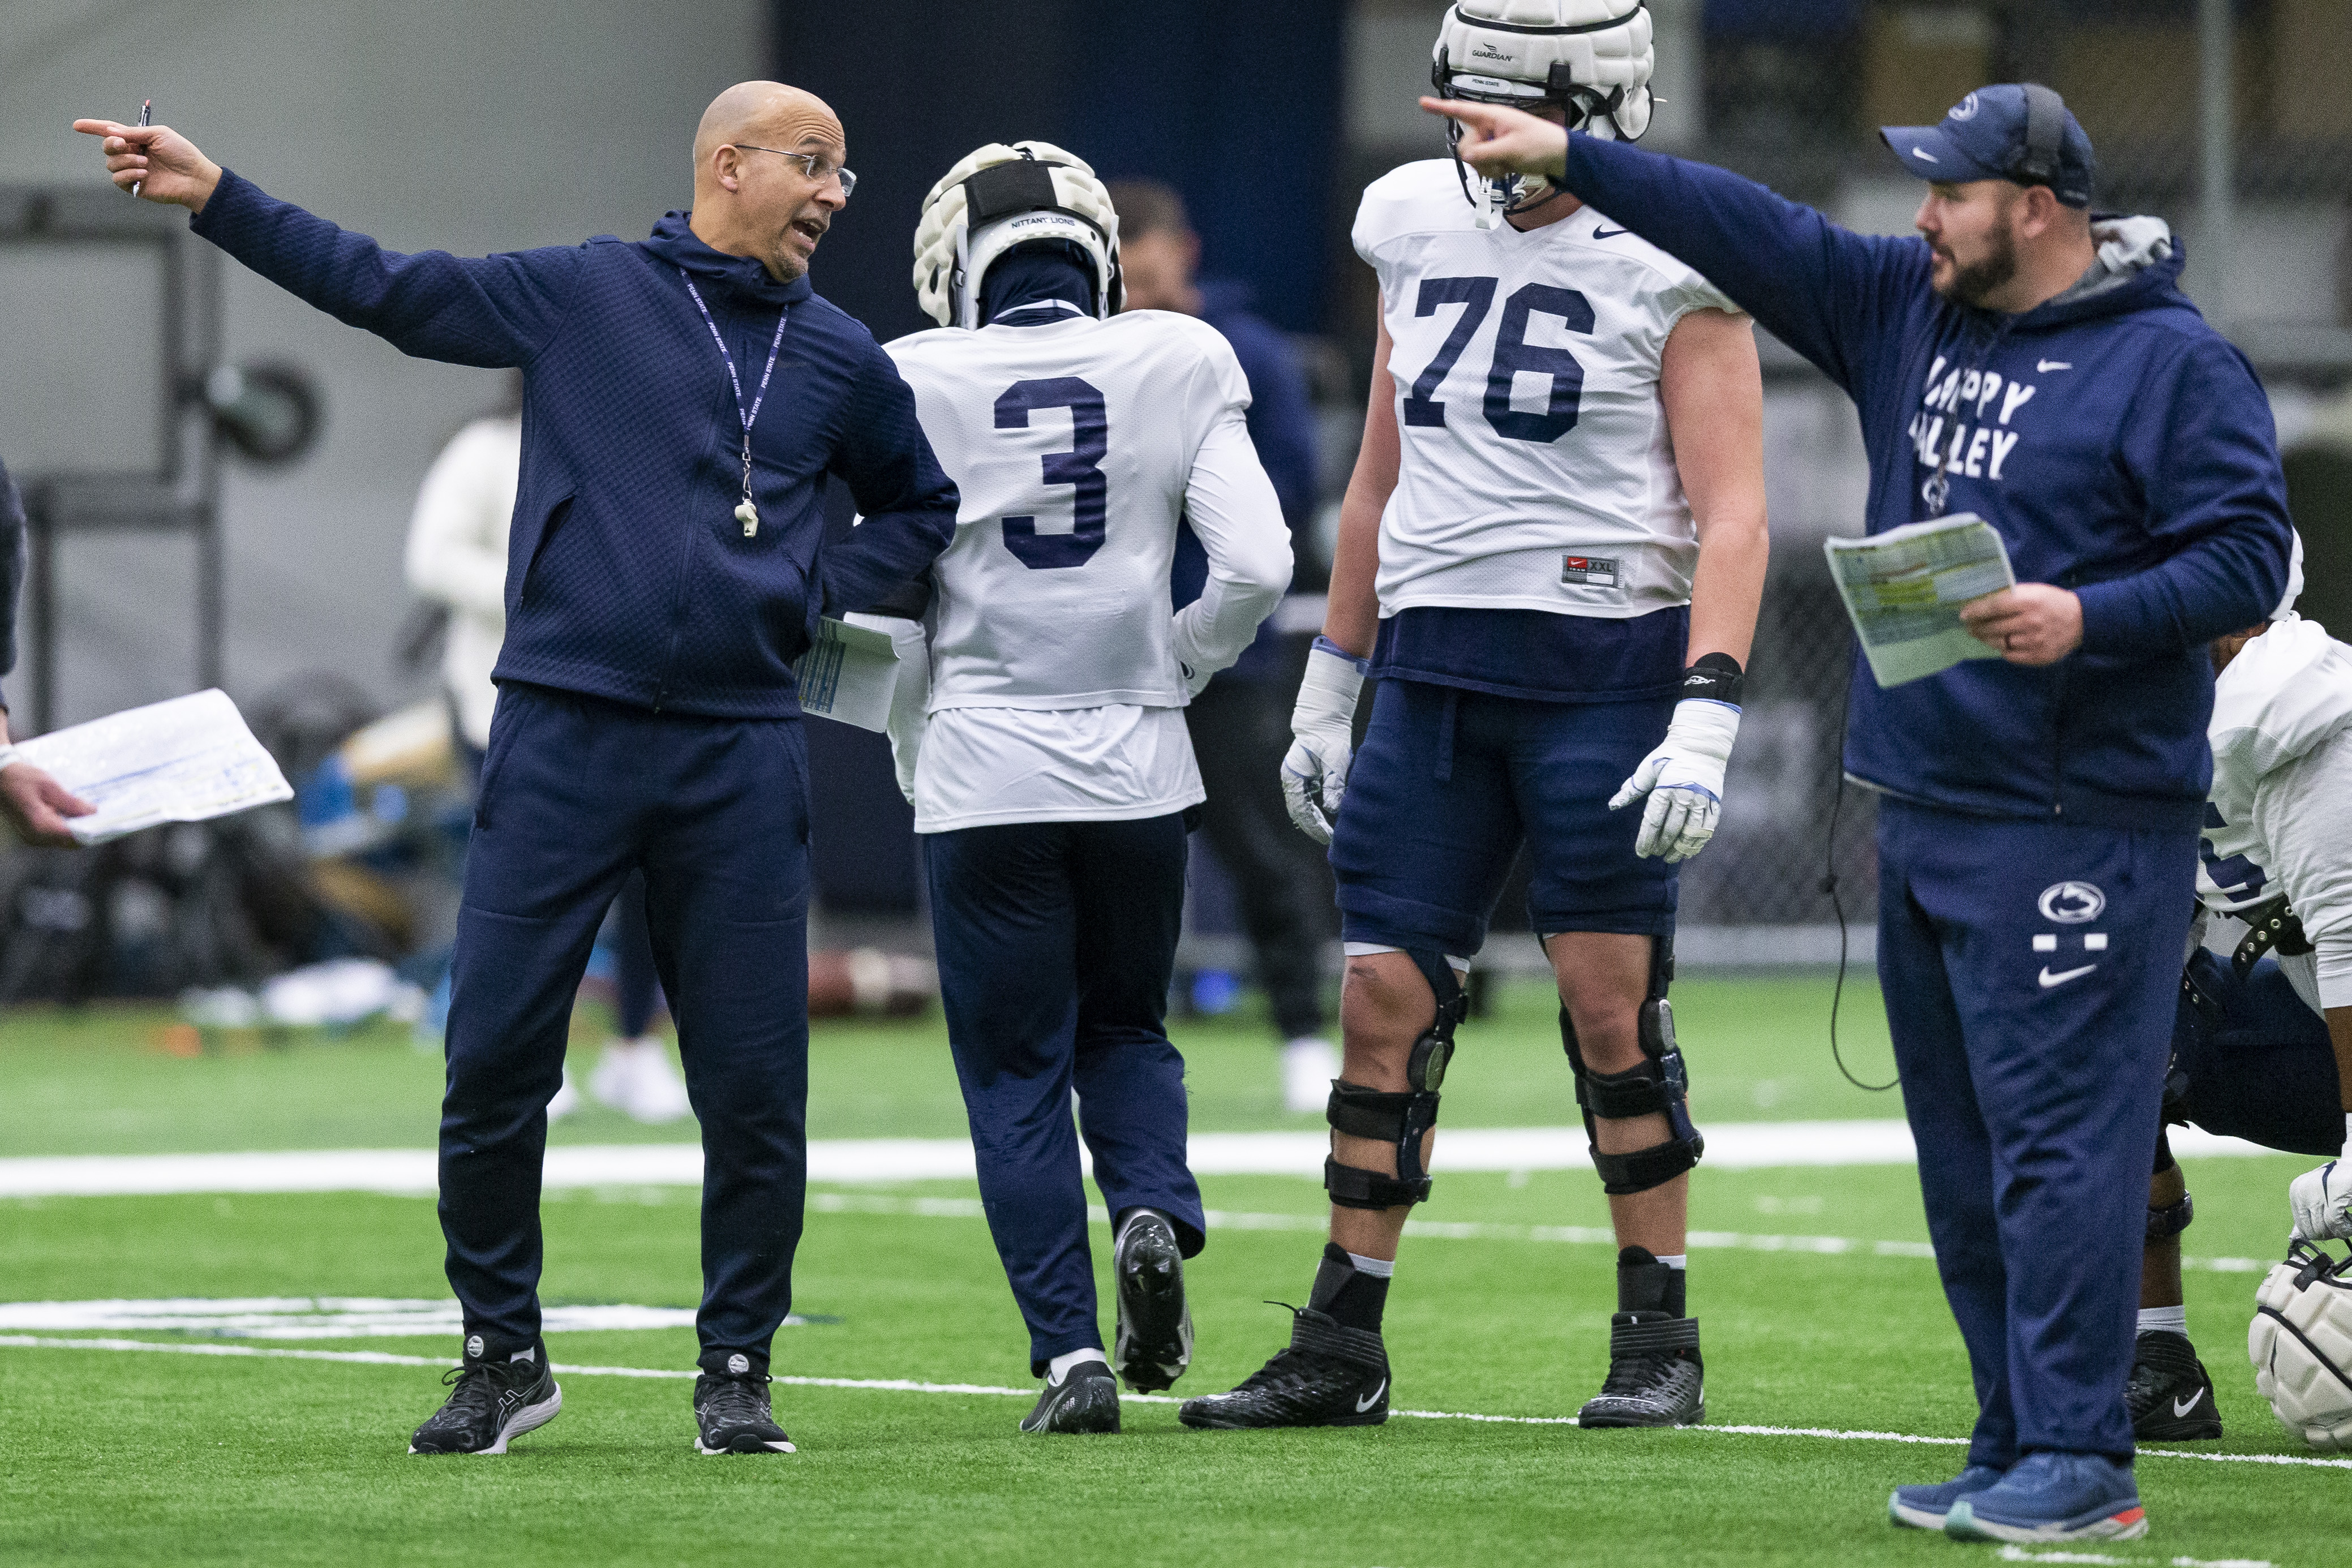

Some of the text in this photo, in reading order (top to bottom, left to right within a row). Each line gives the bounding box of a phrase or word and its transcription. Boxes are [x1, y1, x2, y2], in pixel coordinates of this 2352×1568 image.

[1472, 50, 1513, 62] GUARDIAN
[1011, 217, 1075, 229] NITTANY LIONS
[687, 283, 707, 313] PENN STATE
[709, 322, 728, 353] PENN STATE
[773, 317, 787, 348] PENN STATE
[761, 356, 775, 389] PENN STATE
[1404, 276, 1595, 443] 76
[727, 362, 741, 397] PENN STATE
[752, 397, 762, 414] STATE
[994, 376, 1108, 569] 3
[1590, 561, 1612, 572] XXL
